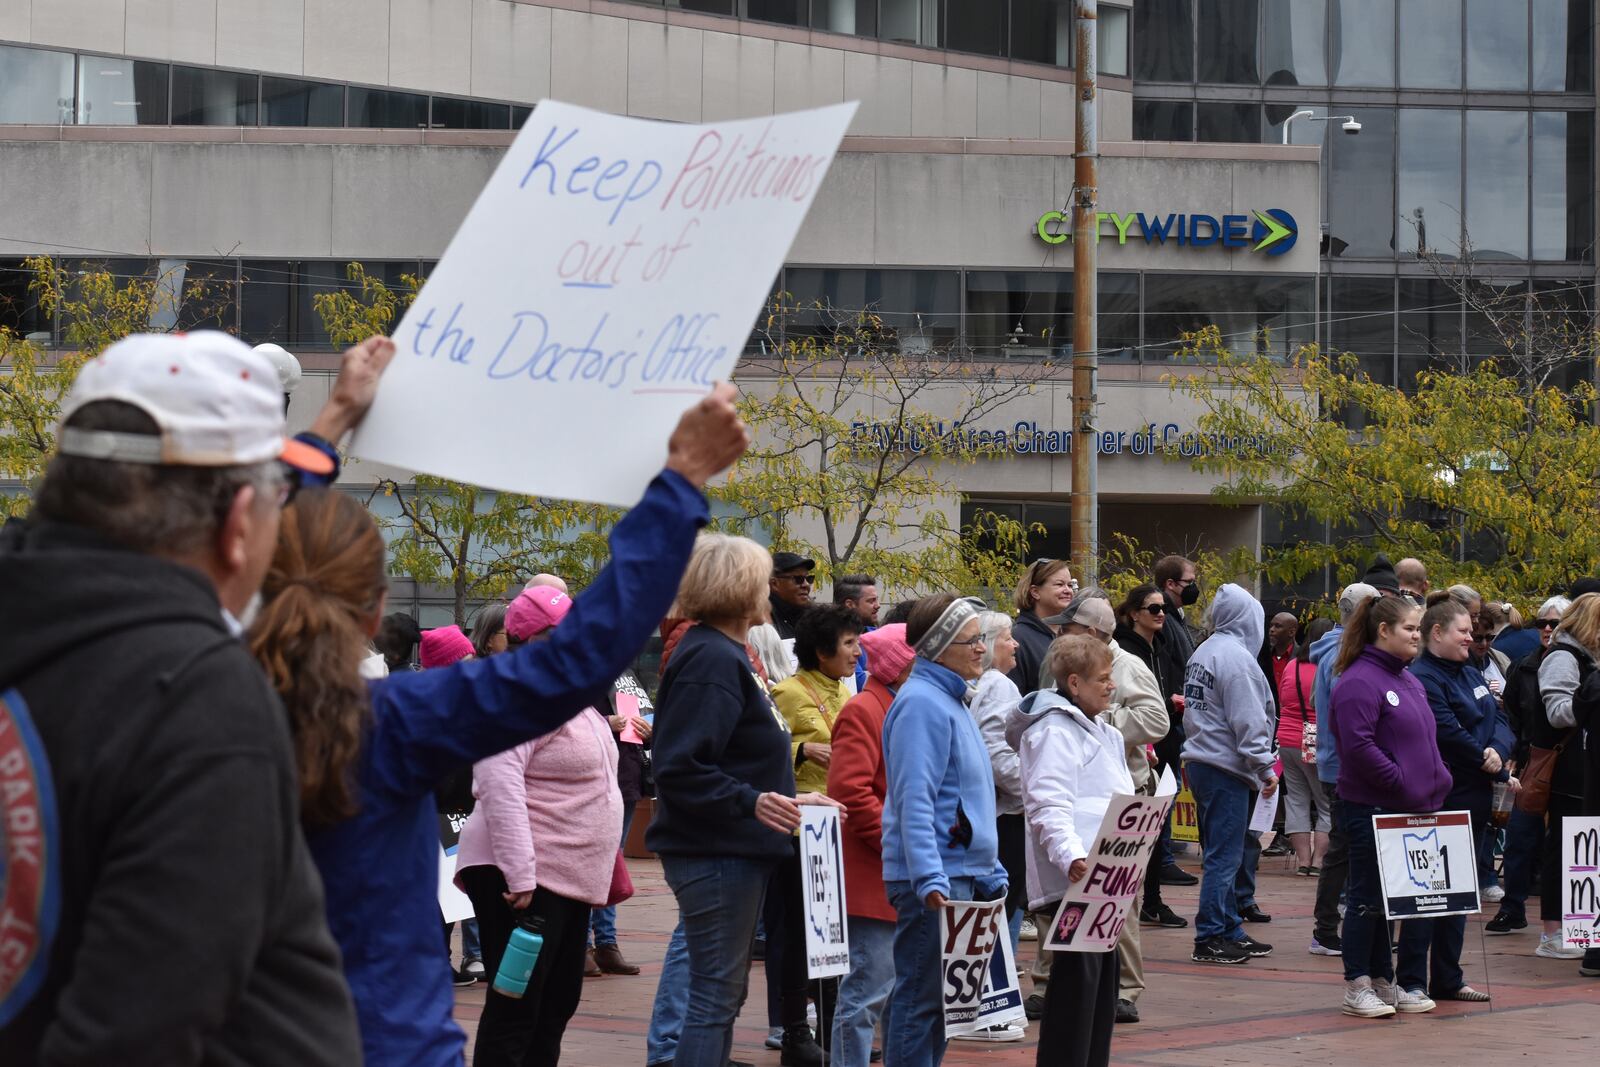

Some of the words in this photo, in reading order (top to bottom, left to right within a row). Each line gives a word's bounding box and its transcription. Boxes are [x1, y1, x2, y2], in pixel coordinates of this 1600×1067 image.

[520, 126, 662, 225] Keep
[1038, 210, 1249, 247] CTYWIDE
[557, 223, 644, 285] out
[642, 219, 700, 283] of
[414, 303, 475, 364] the
[641, 313, 728, 386] Office
[1014, 421, 1126, 454] Chamer
[1131, 424, 1156, 455] of
[941, 601, 972, 633] CAN
[0, 750, 43, 867] PARK
[1099, 835, 1146, 858] want
[1408, 849, 1429, 870] YES
[1439, 844, 1451, 889] 1
[808, 855, 825, 902] YES
[1083, 863, 1144, 897] FUNd
[1431, 880, 1446, 890] ISSUE
[945, 904, 1003, 956] YES
[1087, 902, 1126, 949] Rig
[1567, 923, 1590, 940] Vote
